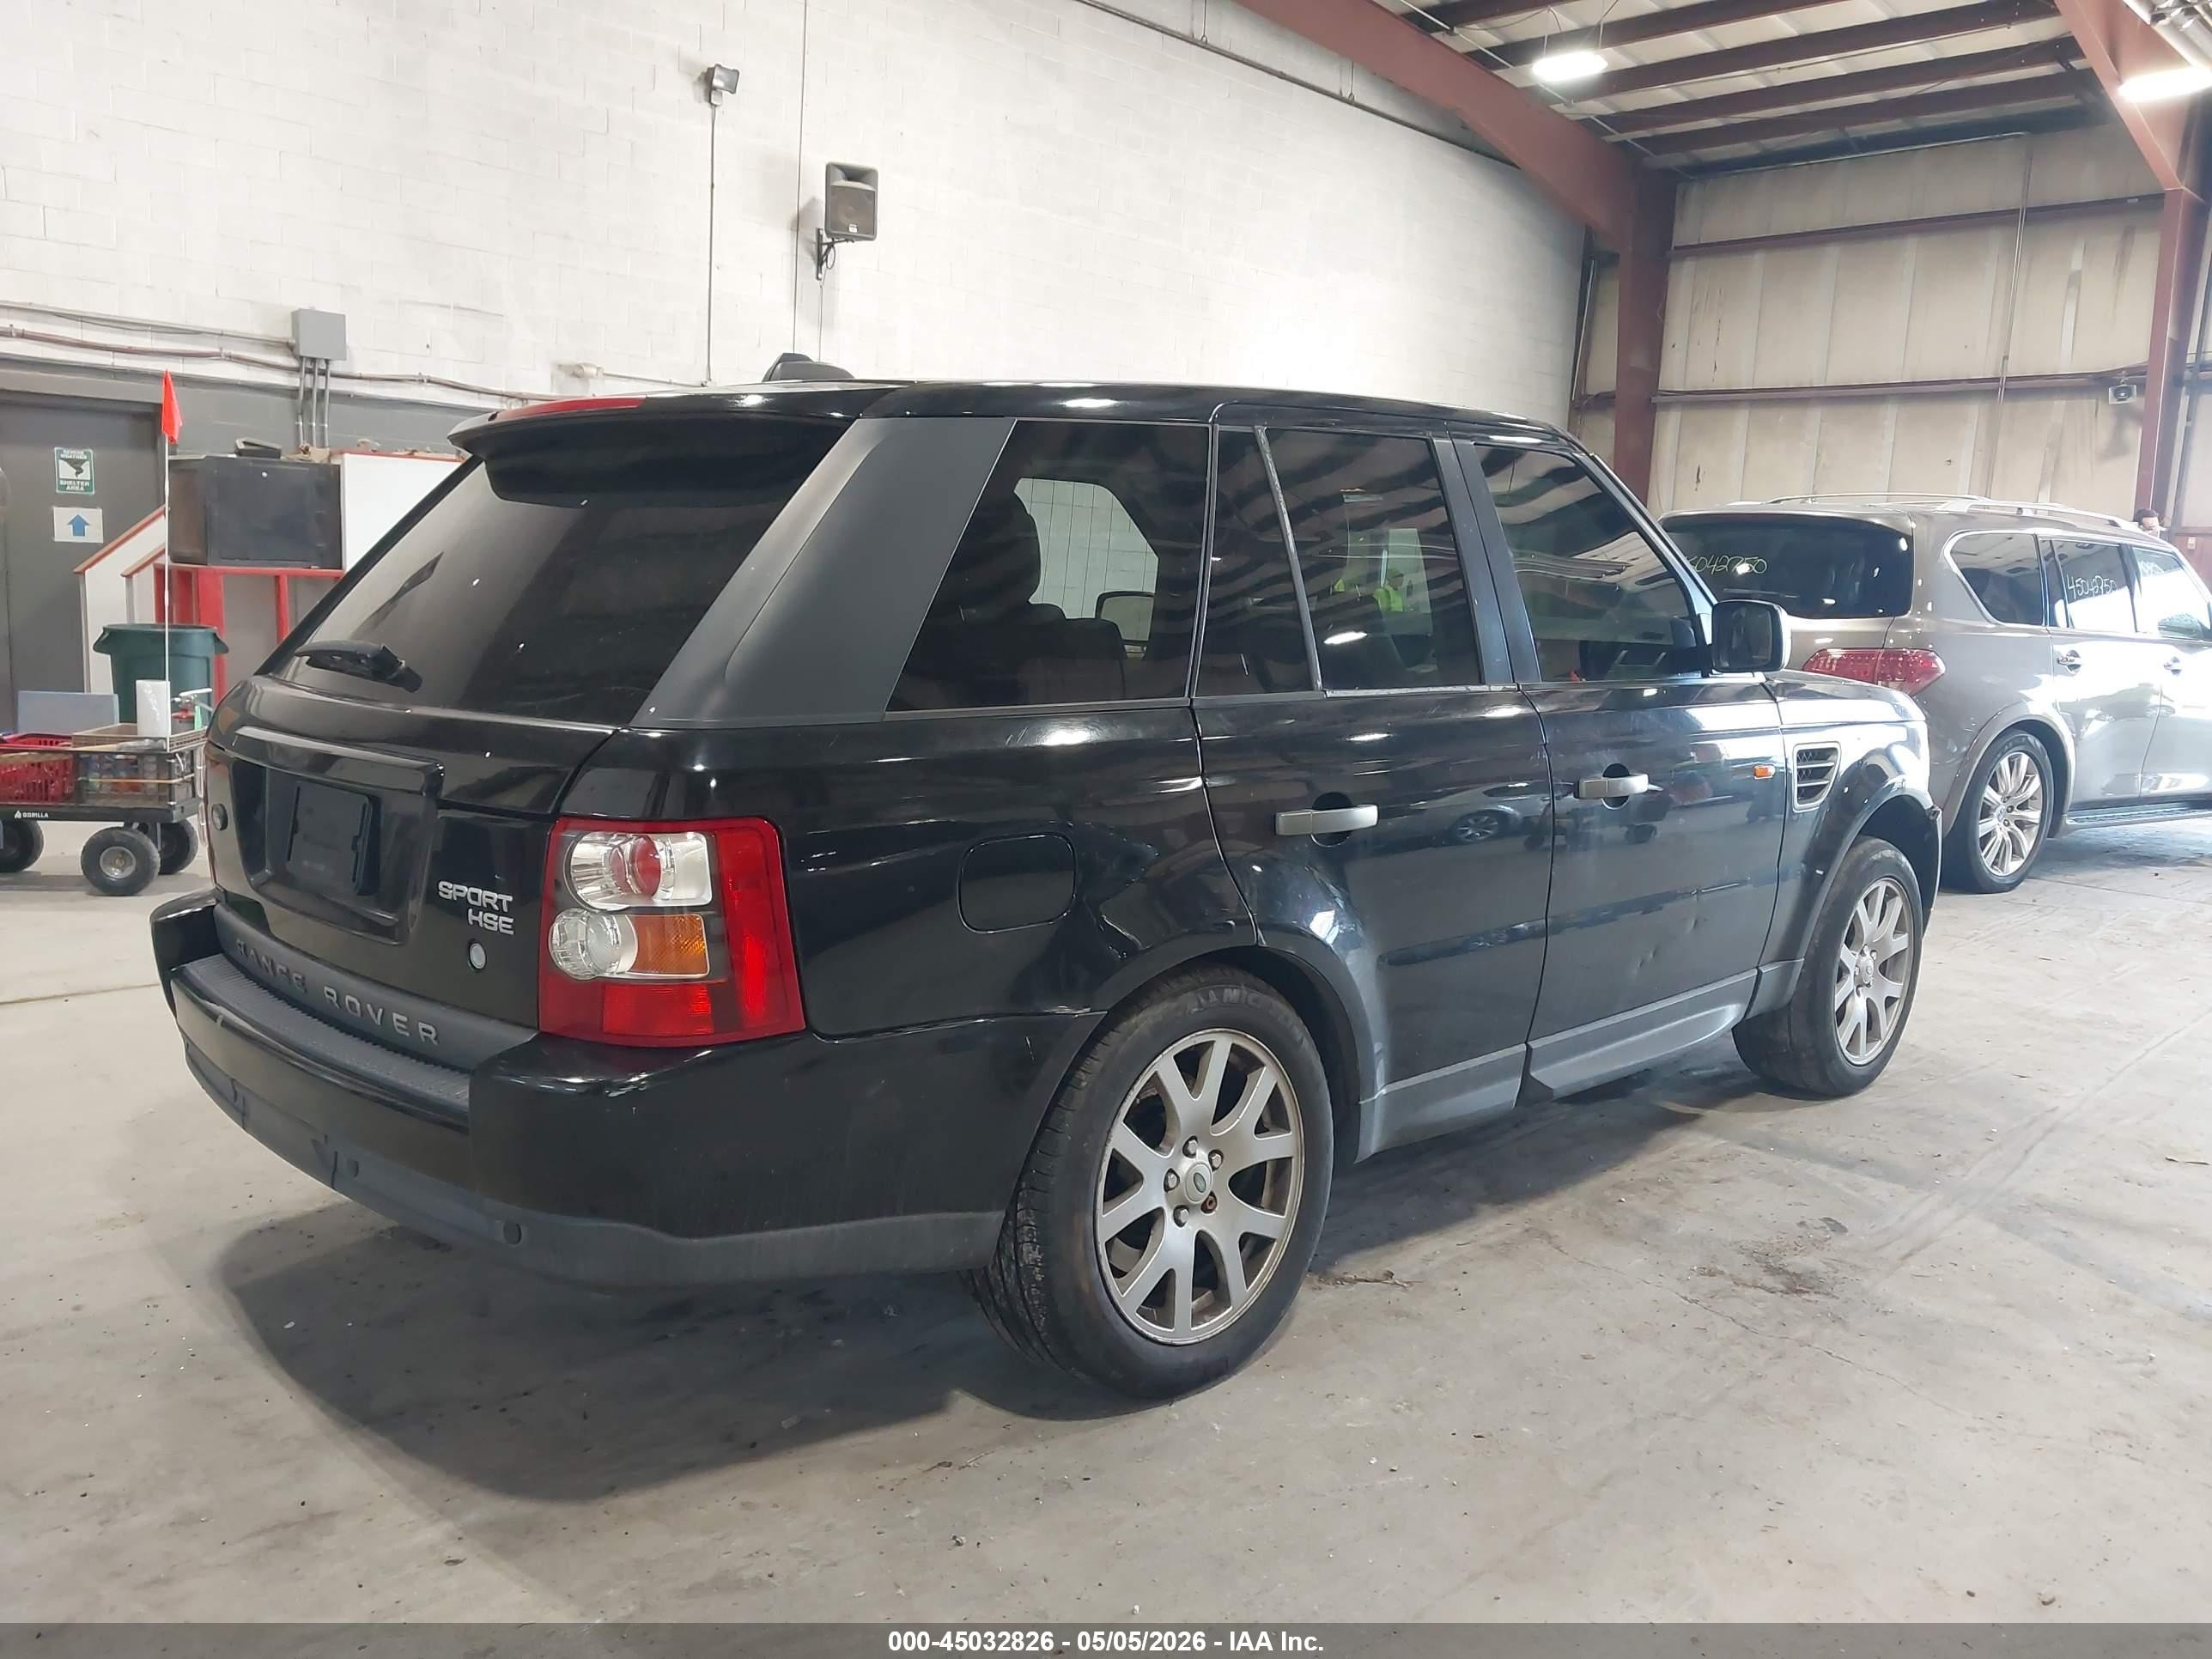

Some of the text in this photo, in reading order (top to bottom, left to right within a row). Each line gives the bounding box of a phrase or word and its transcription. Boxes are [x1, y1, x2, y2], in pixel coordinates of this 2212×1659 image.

[438, 880, 514, 913] SPORT
[468, 908, 514, 935] HSE
[324, 985, 439, 1046] ROVER
